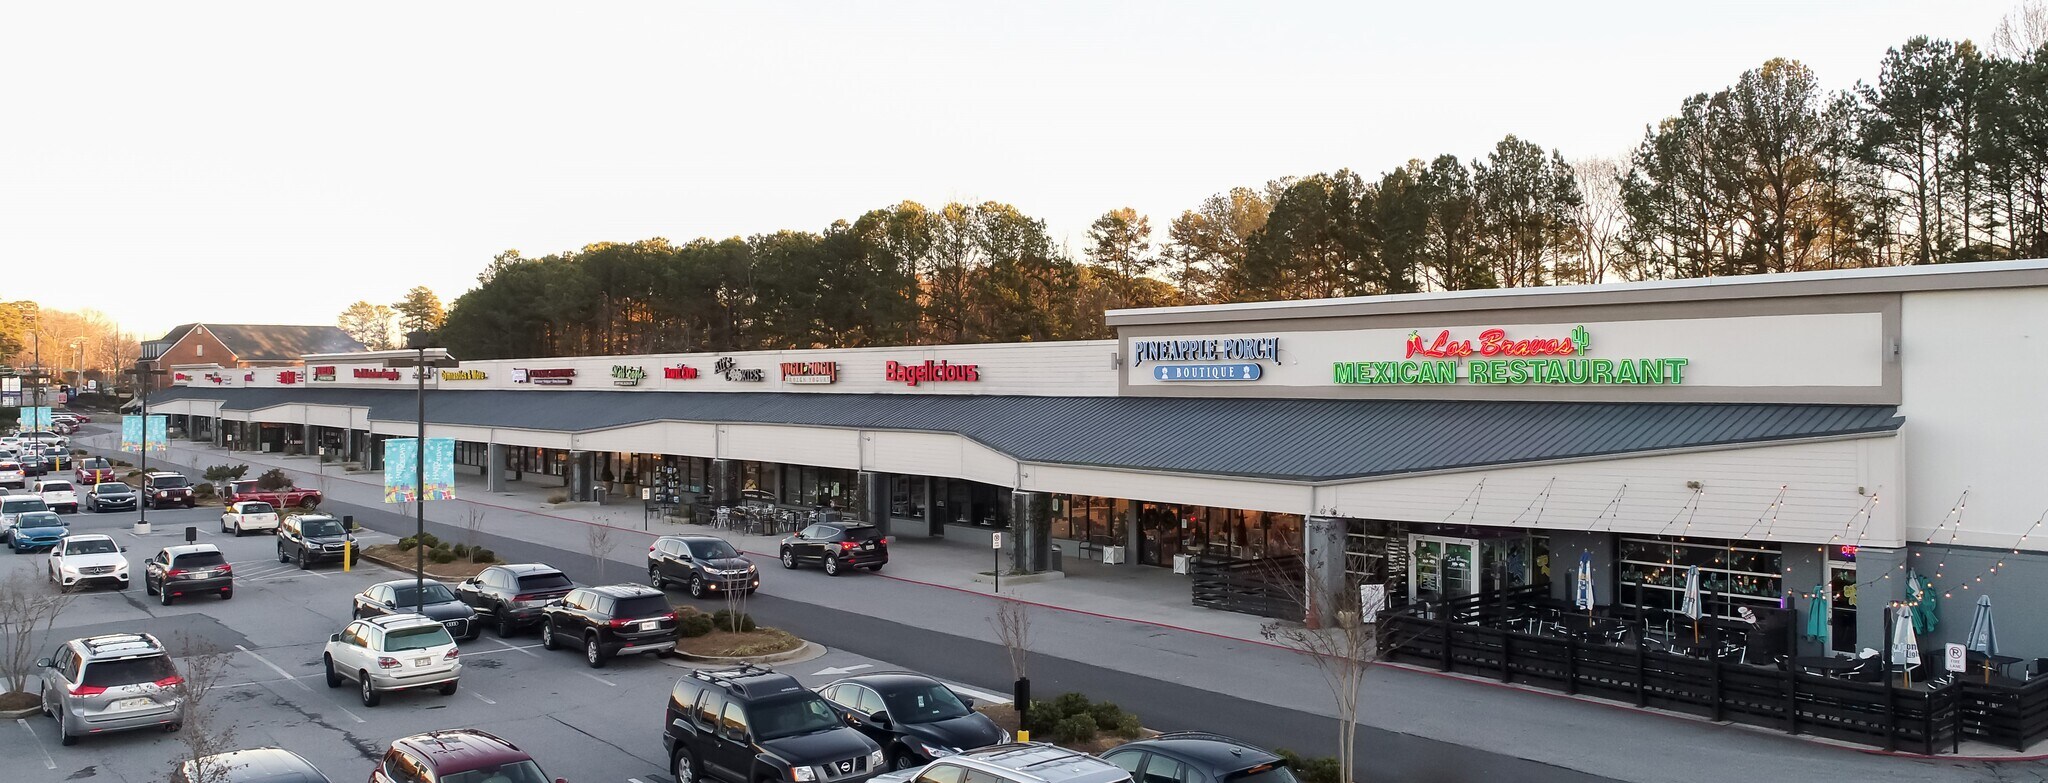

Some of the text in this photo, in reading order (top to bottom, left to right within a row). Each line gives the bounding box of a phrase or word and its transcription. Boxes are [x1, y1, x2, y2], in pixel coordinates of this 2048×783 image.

[1135, 337, 1281, 367] PINEAPPLE PORCH
[1424, 328, 1575, 358] Los Bravos
[725, 368, 762, 383] COOKIES
[780, 361, 837, 381] YOGLI MOGLI
[885, 359, 979, 386] Bagelicious
[1176, 367, 1235, 379] BOUTIQUE
[1333, 358, 1689, 385] MEXICAN RESTAURANT
[1841, 546, 1857, 554] OPE
